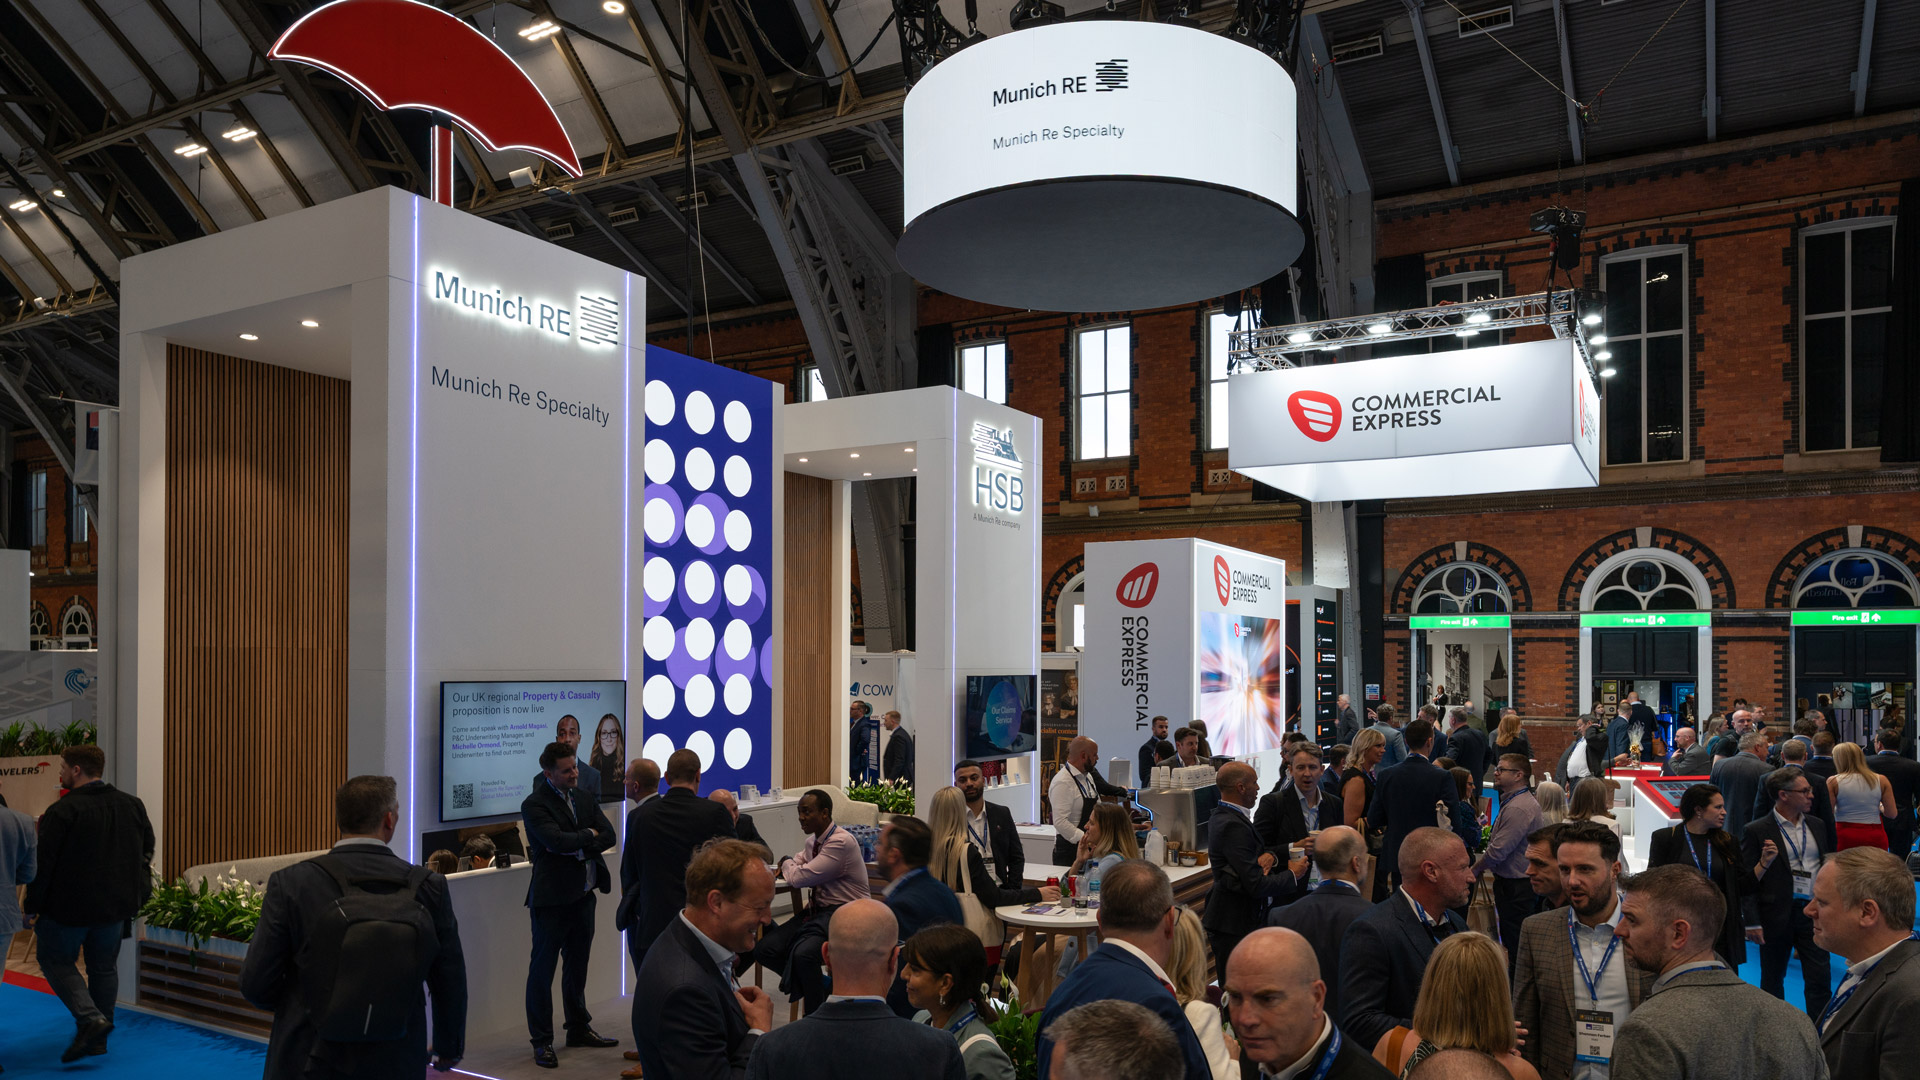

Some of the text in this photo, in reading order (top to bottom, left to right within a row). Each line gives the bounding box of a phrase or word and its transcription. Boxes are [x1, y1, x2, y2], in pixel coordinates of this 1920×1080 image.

[993, 76, 1087, 107] Munich RE
[993, 124, 1125, 150] Munich Re Specialty
[435, 271, 570, 336] Munich RE
[432, 366, 610, 427] Munich Re Specialty
[1352, 385, 1501, 412] COMMERCIAL
[1352, 409, 1442, 432] EXPRESS
[976, 467, 1024, 512] HSB
[1233, 570, 1271, 590] COMMERCIAL
[1233, 586, 1257, 603] EXPRESS
[1122, 616, 1134, 686] EXPRESS
[1136, 616, 1148, 731] COMMERCIAL
[452, 690, 600, 703] Our UK regional Property & Casualty
[862, 684, 894, 696] COW
[453, 705, 500, 718] proposition
[504, 705, 510, 714] is
[531, 704, 544, 713] live
